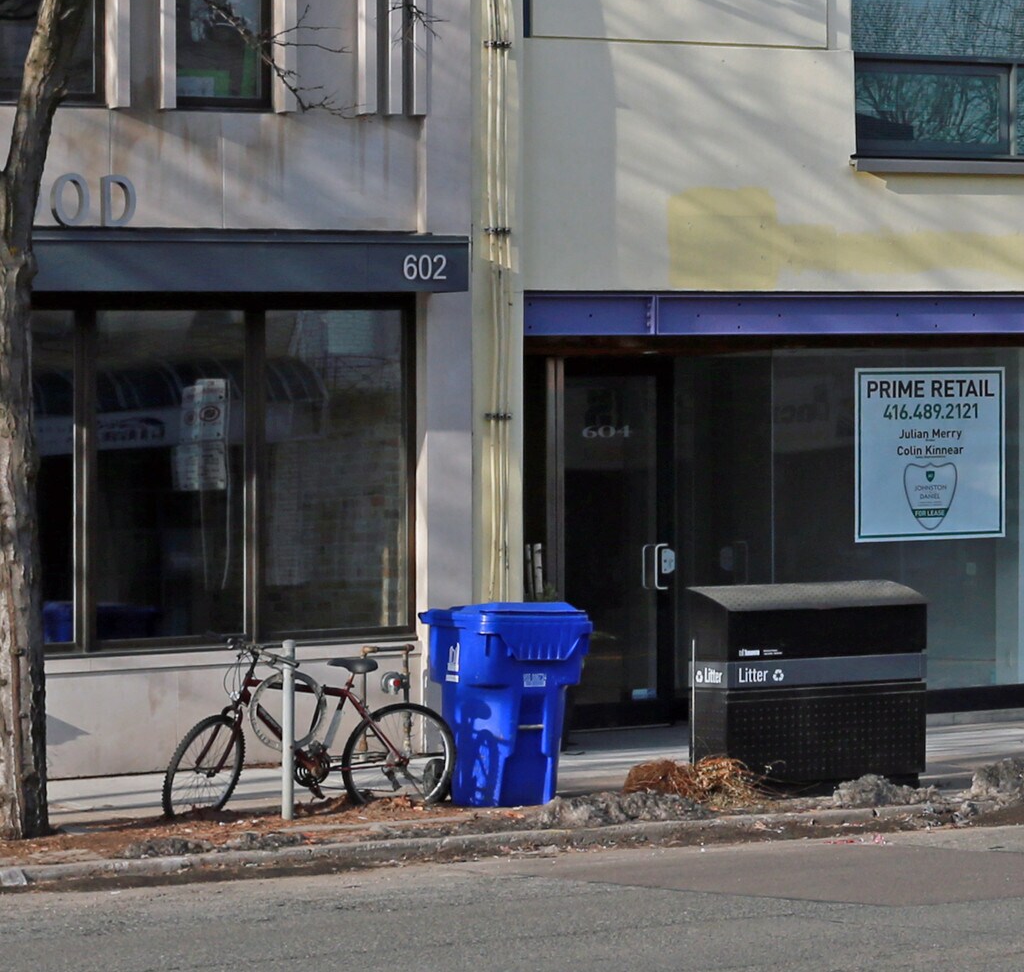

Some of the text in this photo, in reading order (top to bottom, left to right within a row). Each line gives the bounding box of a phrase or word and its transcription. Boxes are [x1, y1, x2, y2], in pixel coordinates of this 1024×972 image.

[50, 173, 137, 227] OD
[403, 254, 447, 280] 602
[866, 379, 995, 398] PRIME RETAIL
[883, 403, 979, 420] 416.489.2121
[899, 429, 962, 440] Julian Merry
[897, 445, 964, 456] Colin Kinnear
[704, 667, 722, 684] Litter
[739, 668, 768, 683] Litter
